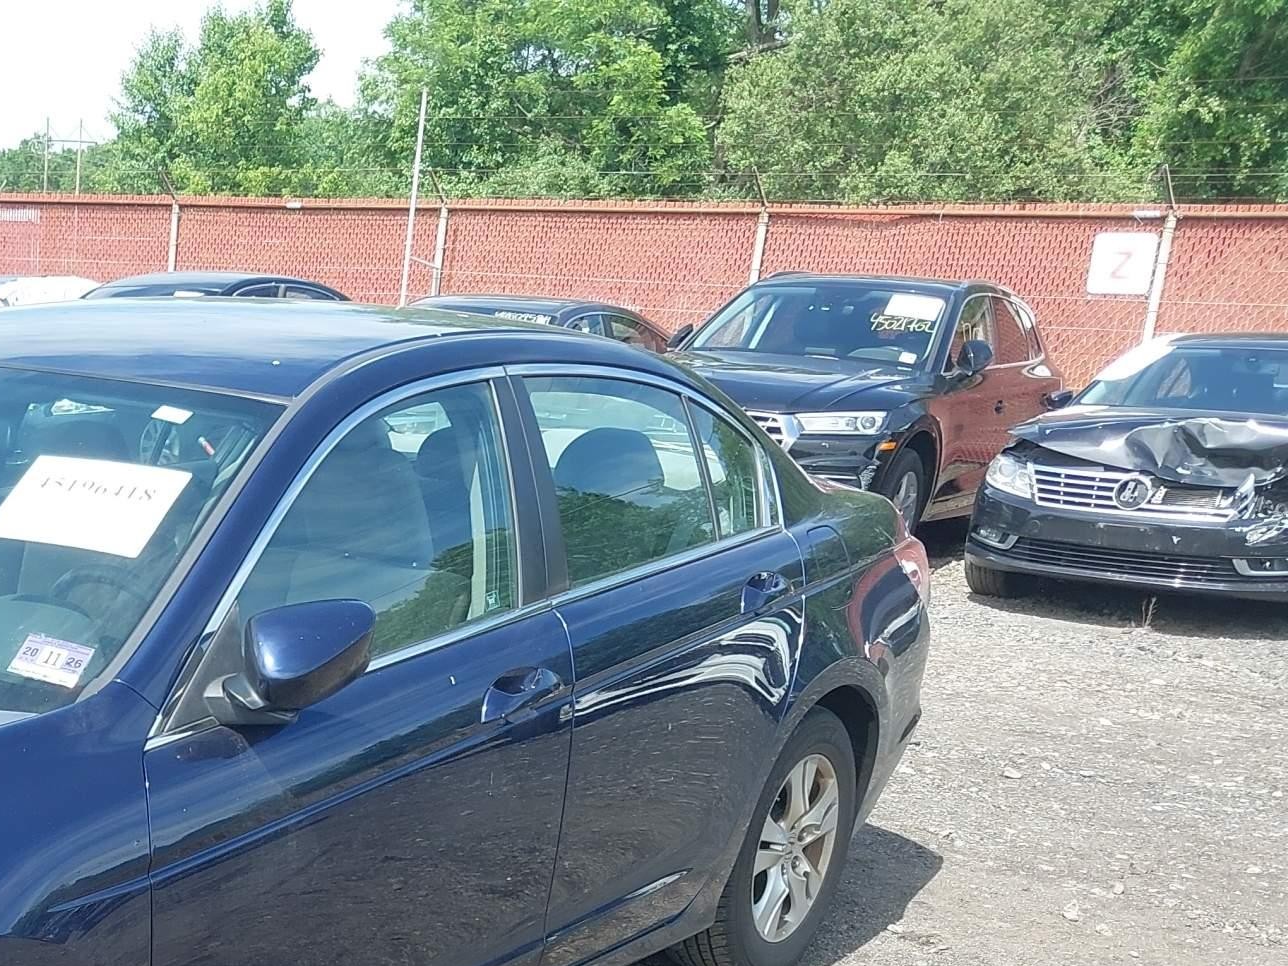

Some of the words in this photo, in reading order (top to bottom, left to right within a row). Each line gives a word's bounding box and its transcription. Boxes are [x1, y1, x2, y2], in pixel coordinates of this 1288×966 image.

[1110, 250, 1133, 279] Z
[22, 646, 39, 657] 20
[43, 650, 62, 666] 11
[65, 657, 83, 669] 26
